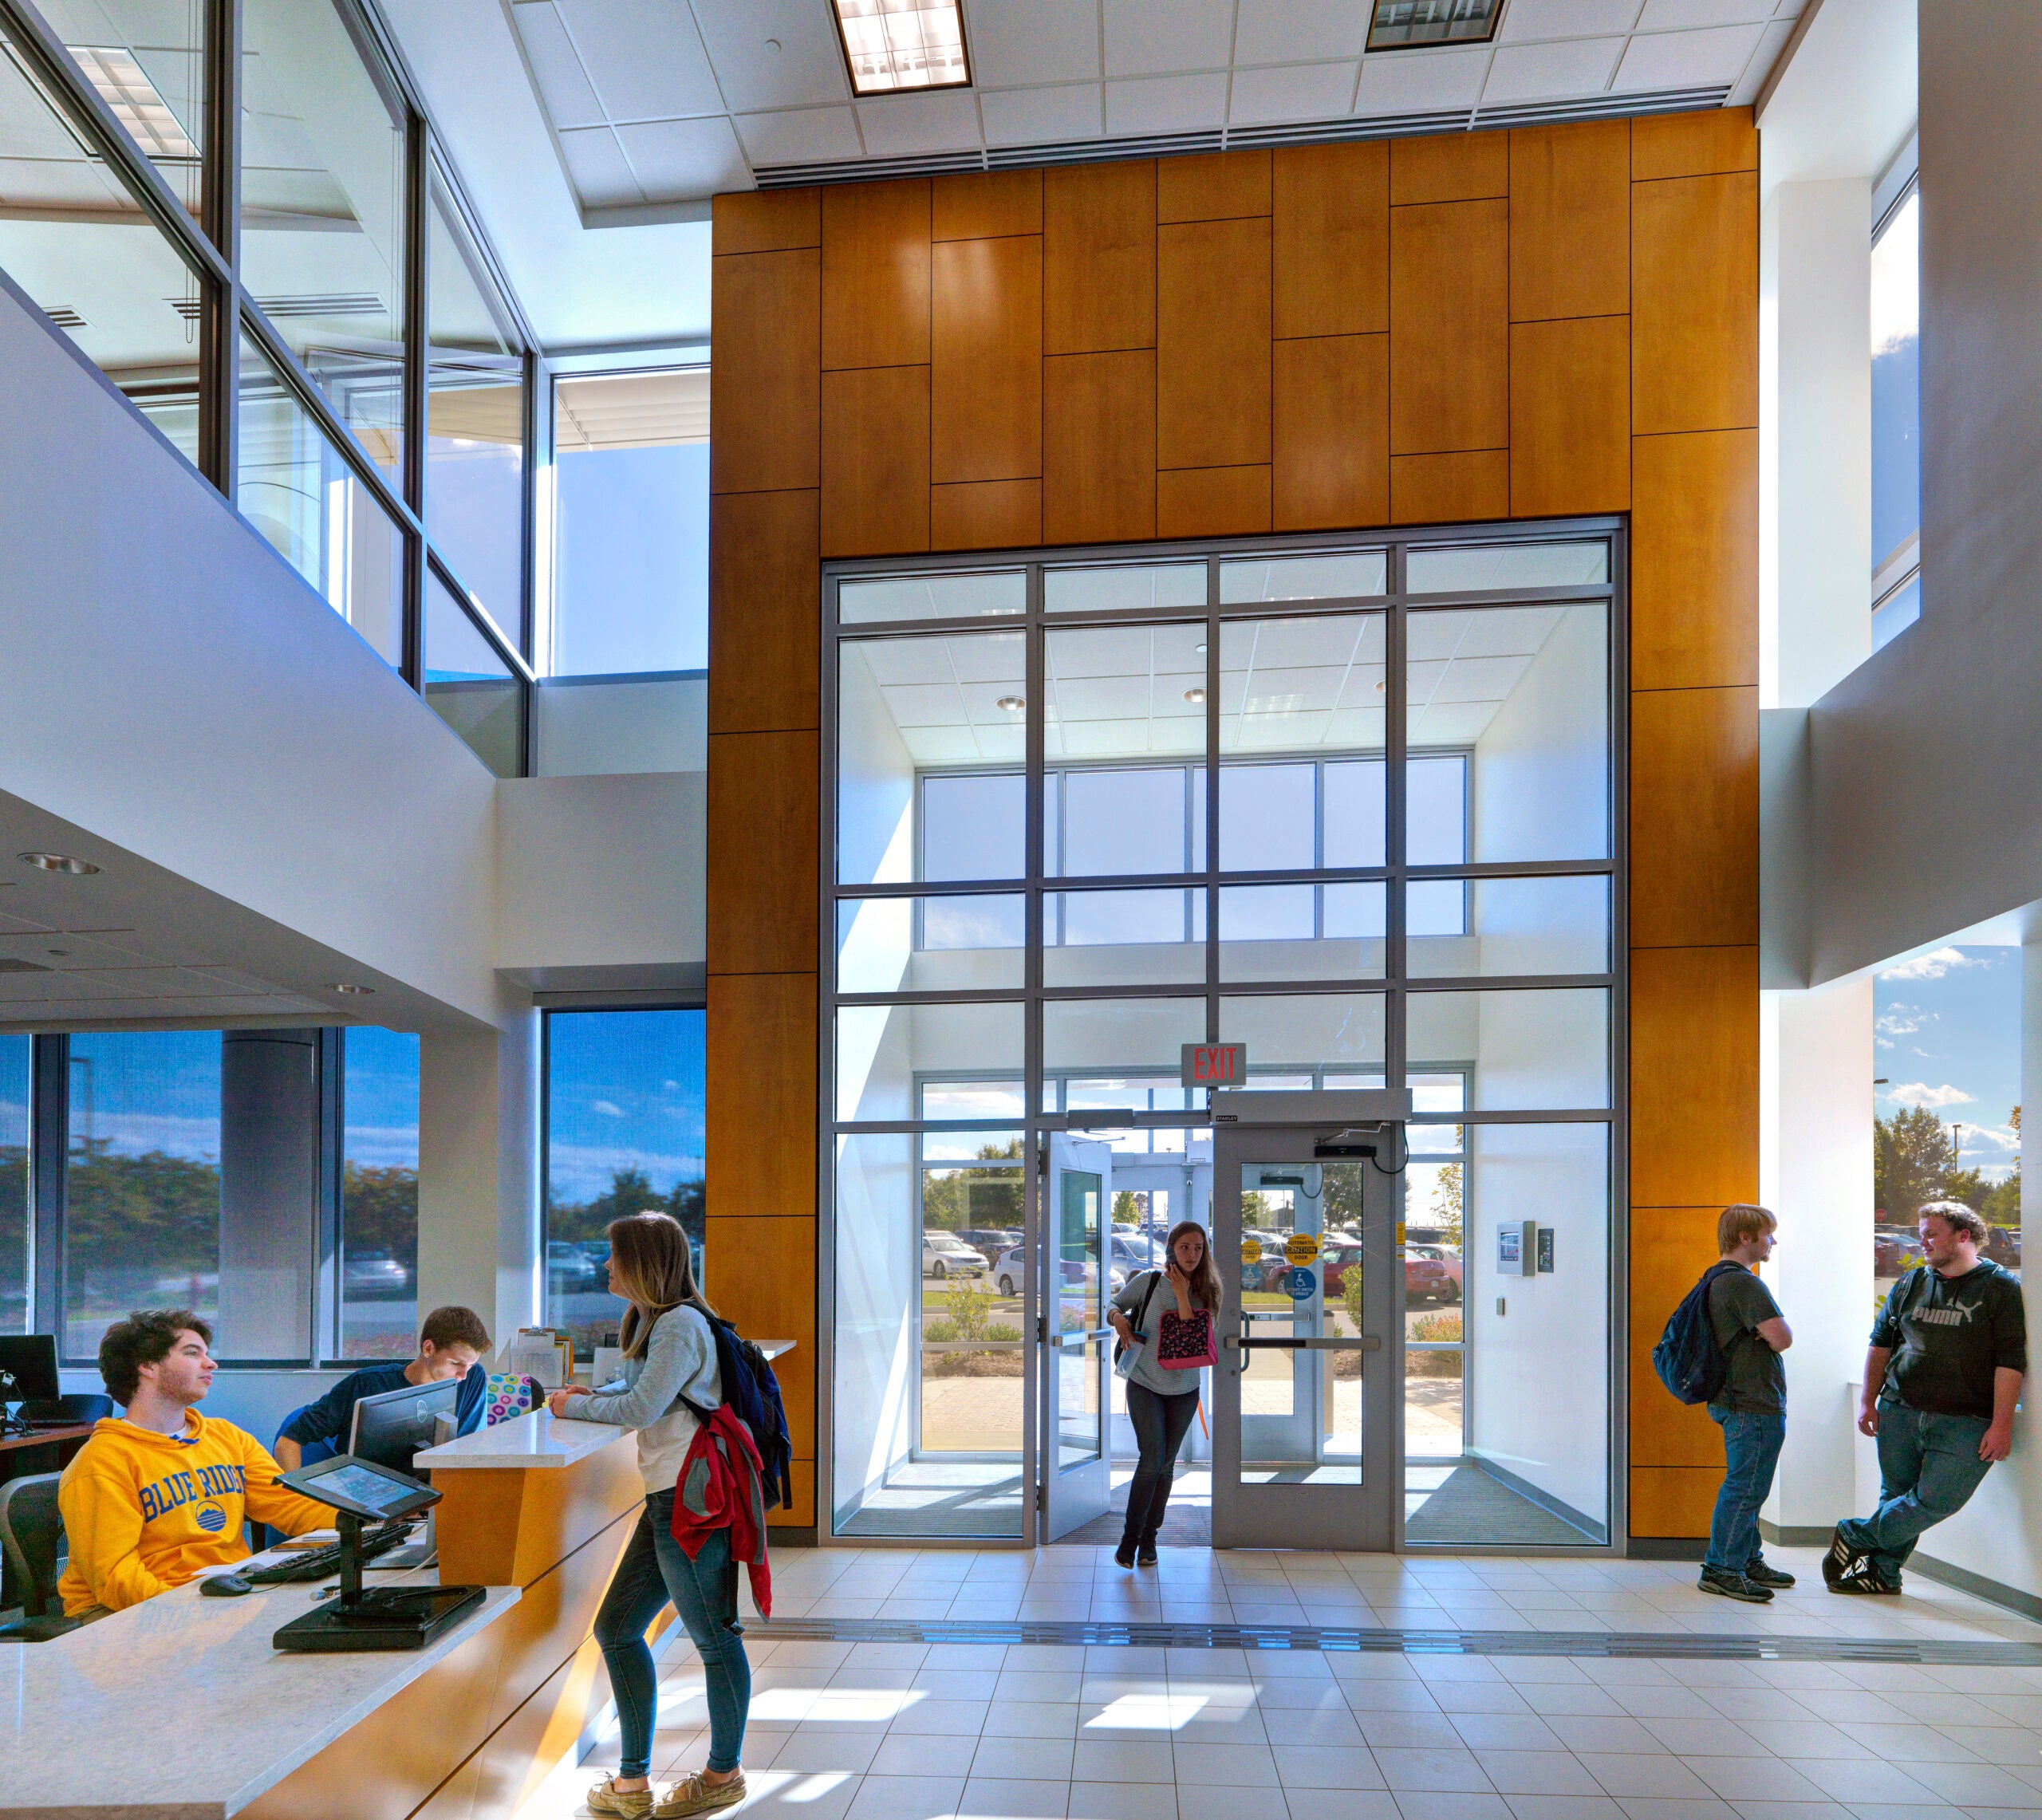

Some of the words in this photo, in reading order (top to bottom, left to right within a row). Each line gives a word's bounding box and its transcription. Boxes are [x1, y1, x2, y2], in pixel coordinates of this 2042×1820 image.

[1194, 1047, 1237, 1080] EXIT
[1911, 1306, 1963, 1326] PUMA
[139, 1471, 198, 1524] BLUE
